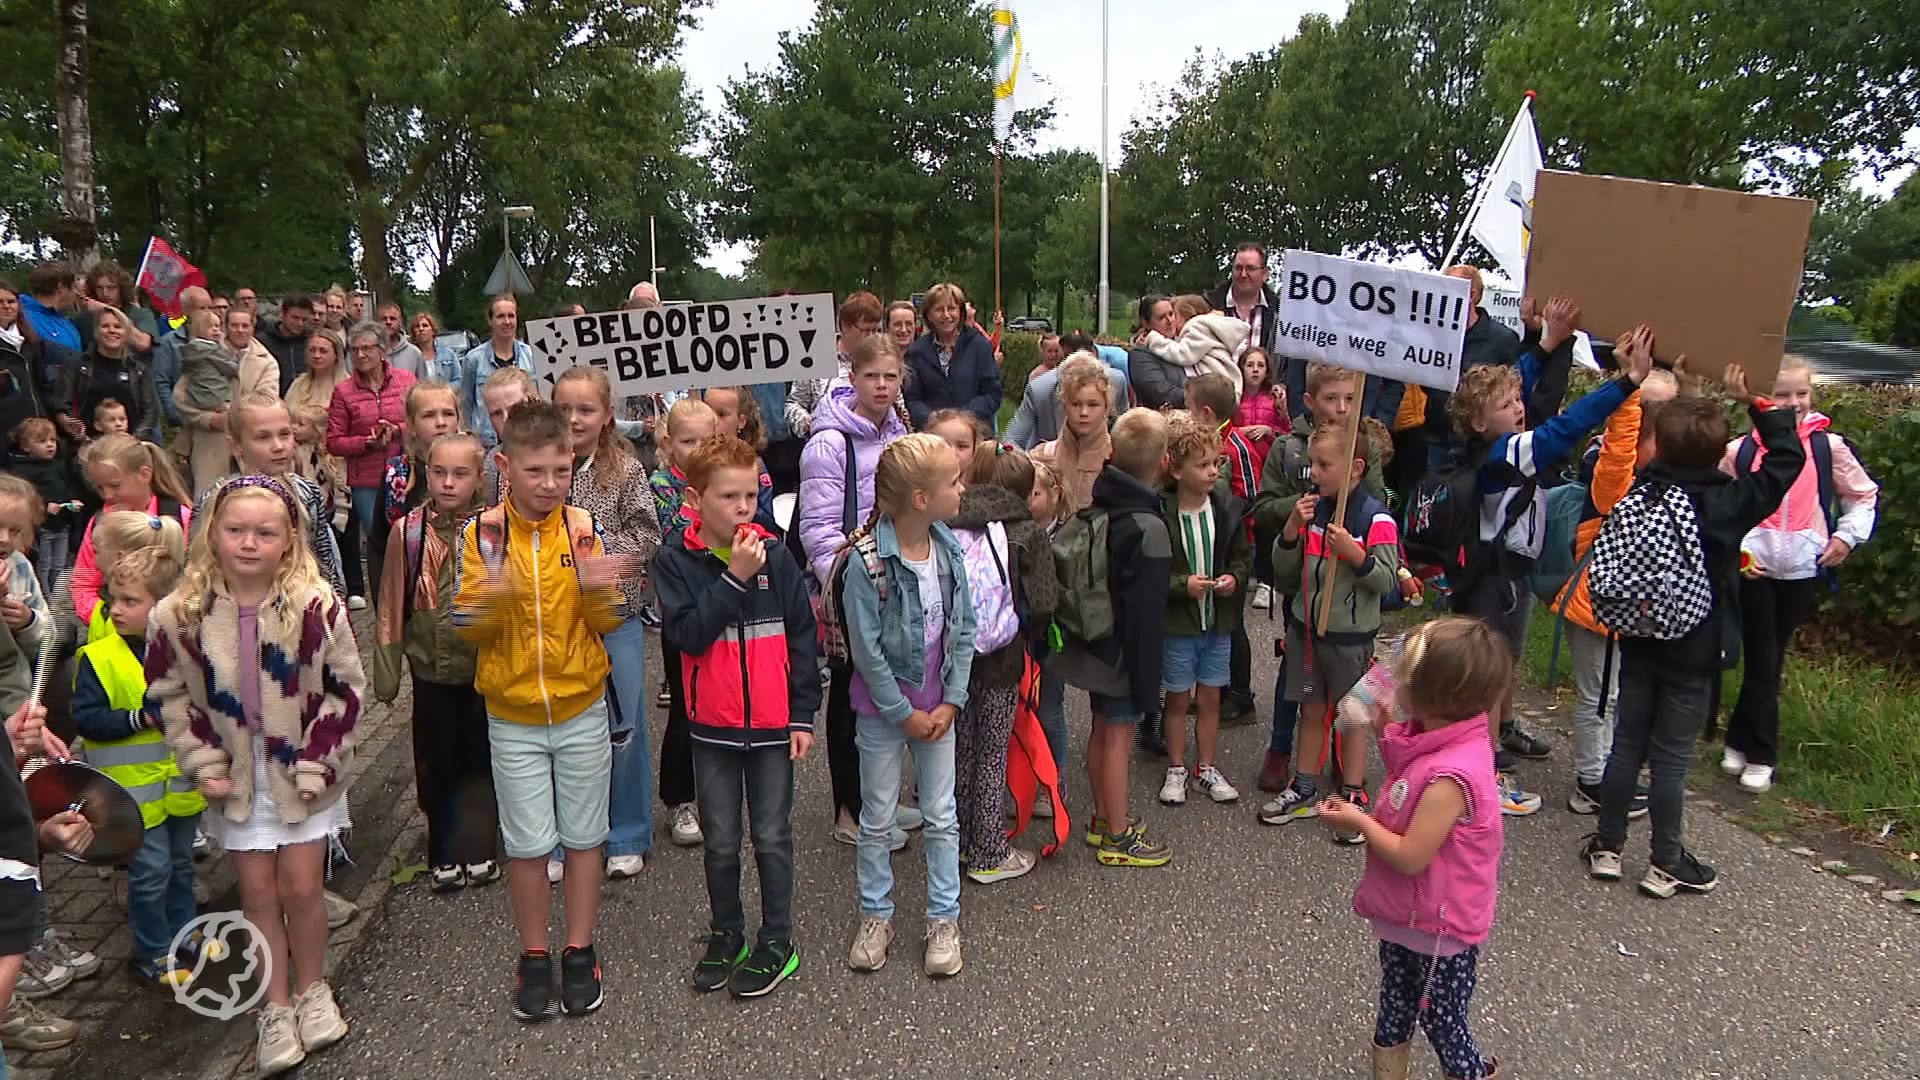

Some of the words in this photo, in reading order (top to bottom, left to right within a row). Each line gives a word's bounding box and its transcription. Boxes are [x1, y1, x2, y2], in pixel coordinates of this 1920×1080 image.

[573, 304, 730, 347] BELOOFD
[1410, 290, 1464, 330] !!!!
[1279, 320, 1337, 348] Veilige
[1348, 335, 1387, 357] weg
[1403, 345, 1453, 370] AUB!
